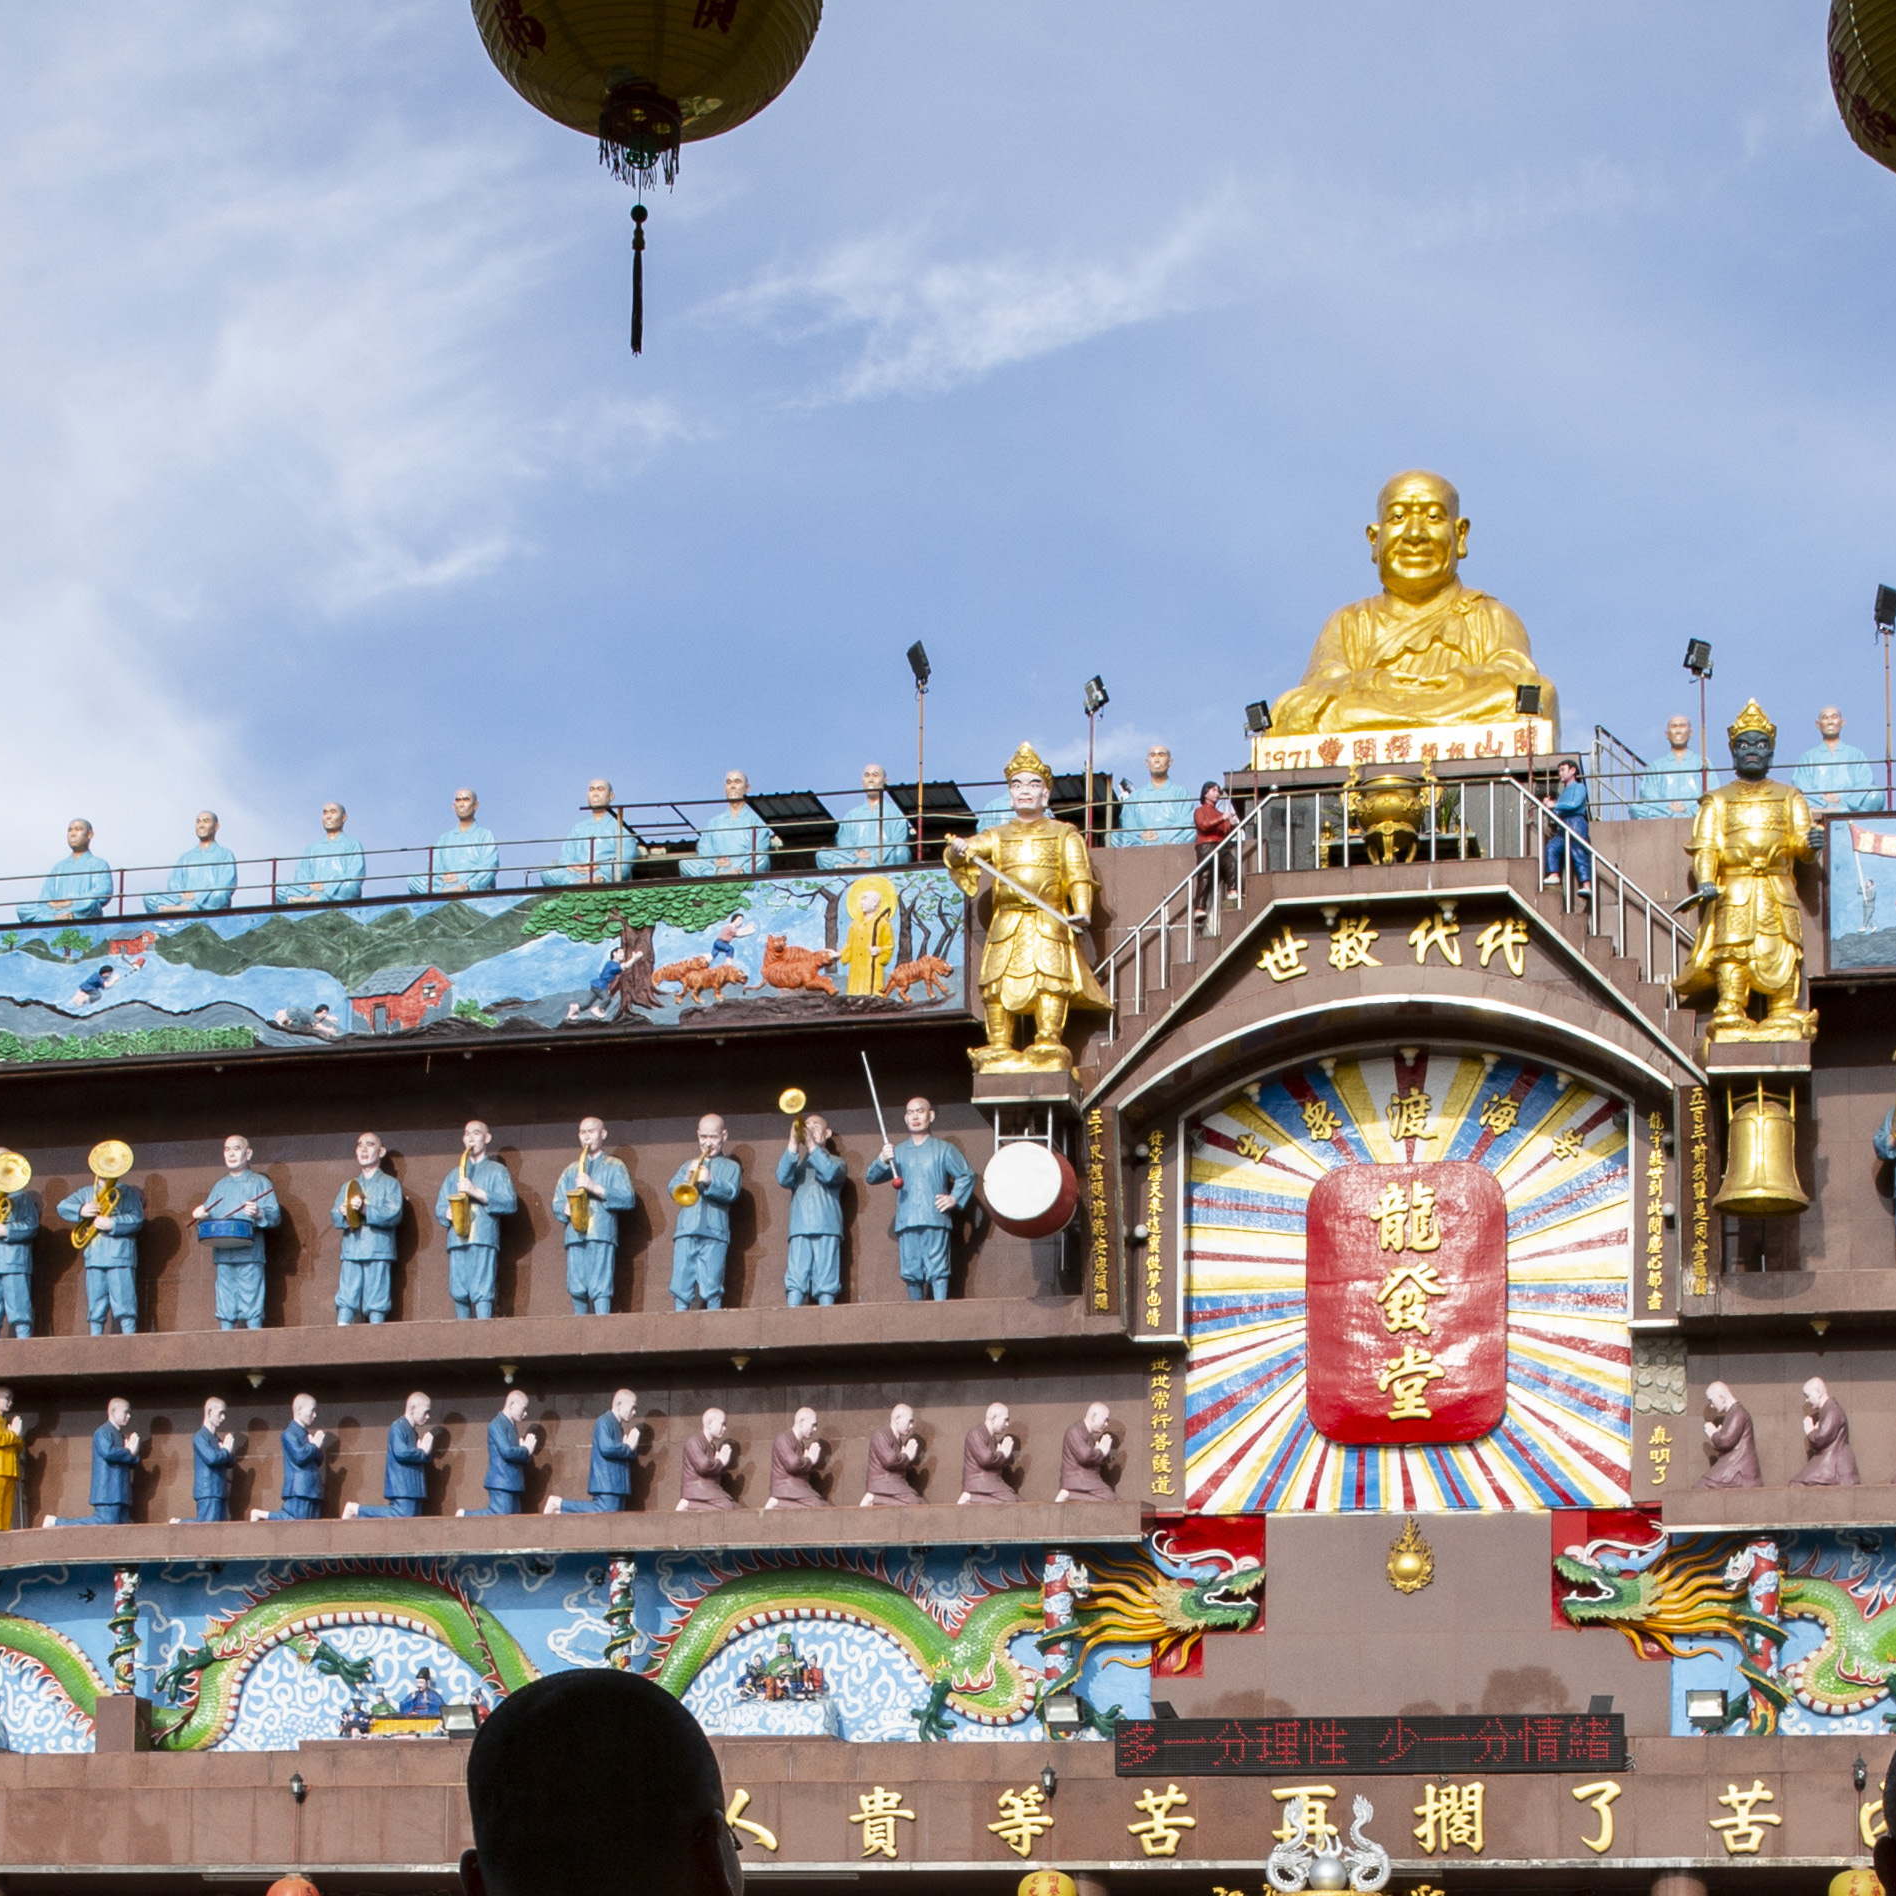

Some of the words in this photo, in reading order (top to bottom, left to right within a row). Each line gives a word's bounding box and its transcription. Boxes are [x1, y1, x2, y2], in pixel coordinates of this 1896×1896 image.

[1256, 913, 1529, 982] 代代救世
[1370, 1180, 1447, 1422] 龍發堂
[1119, 1719, 1349, 1766] 多一分理性
